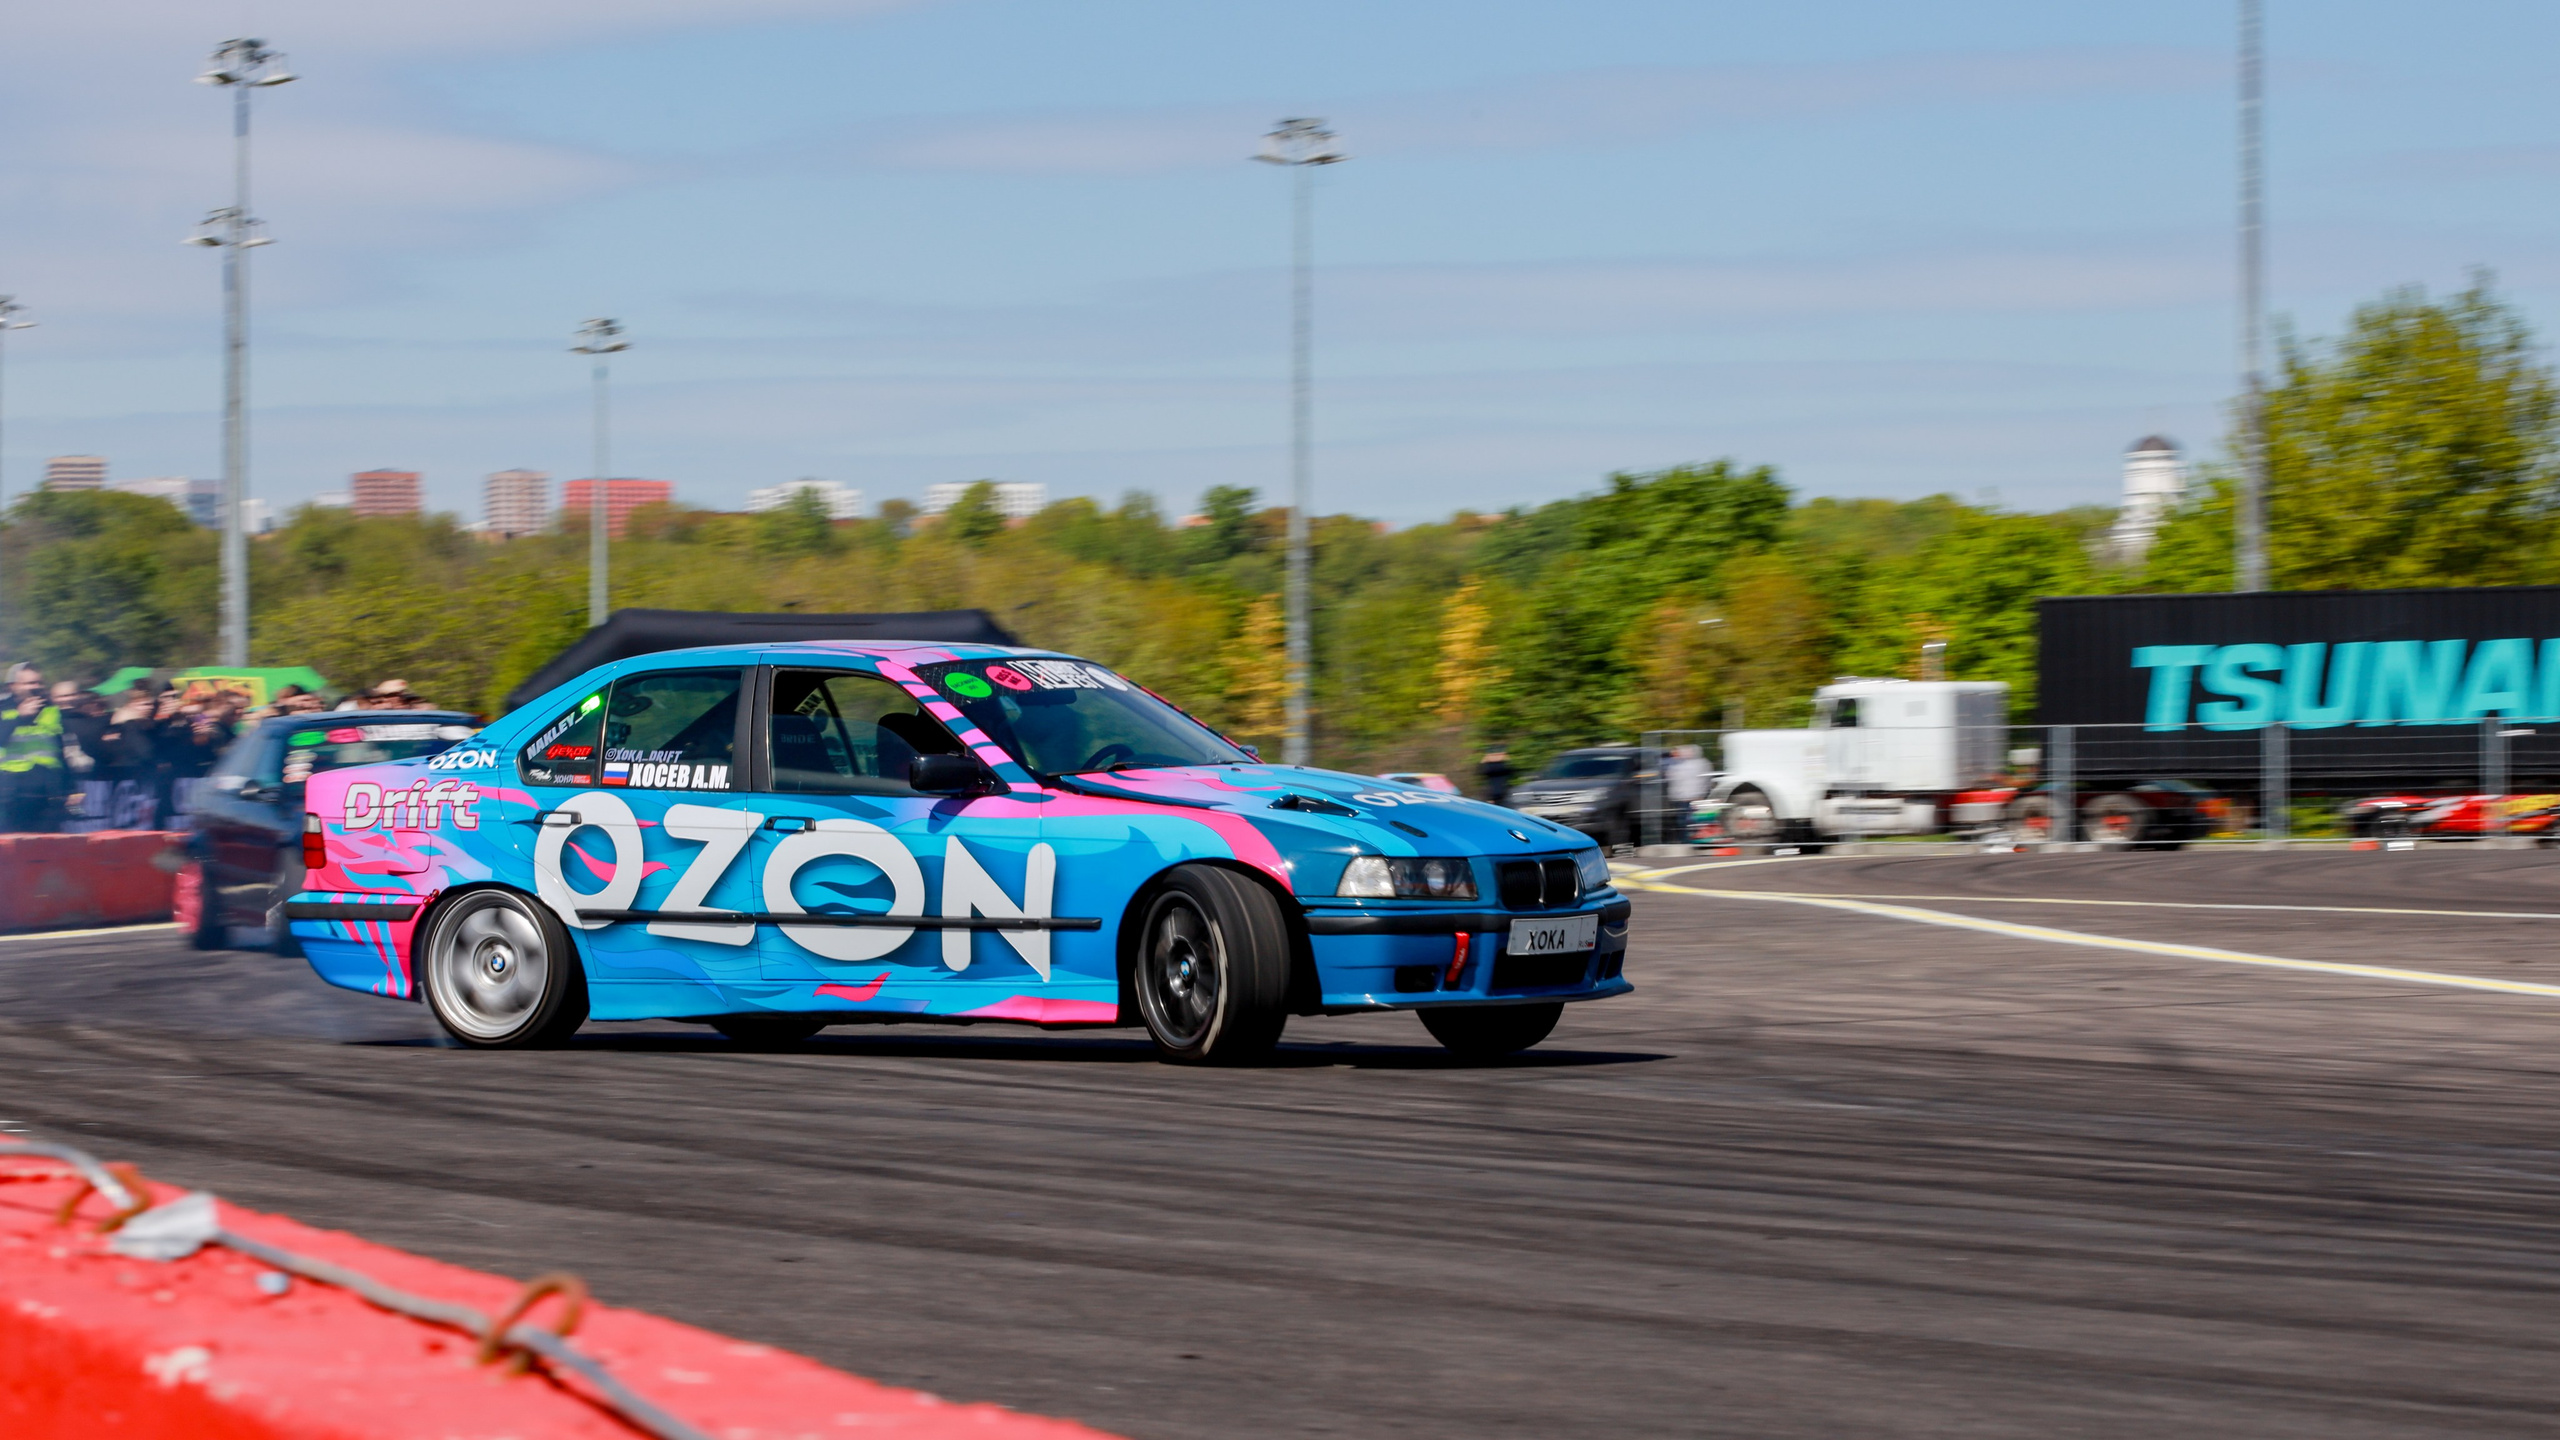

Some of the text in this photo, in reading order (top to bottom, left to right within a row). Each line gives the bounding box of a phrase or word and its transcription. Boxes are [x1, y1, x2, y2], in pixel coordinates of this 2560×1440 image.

[427, 749, 498, 770] OZON
[629, 763, 691, 788] ХОСЕВ
[343, 779, 480, 830] Drift
[534, 792, 1057, 982] OZON
